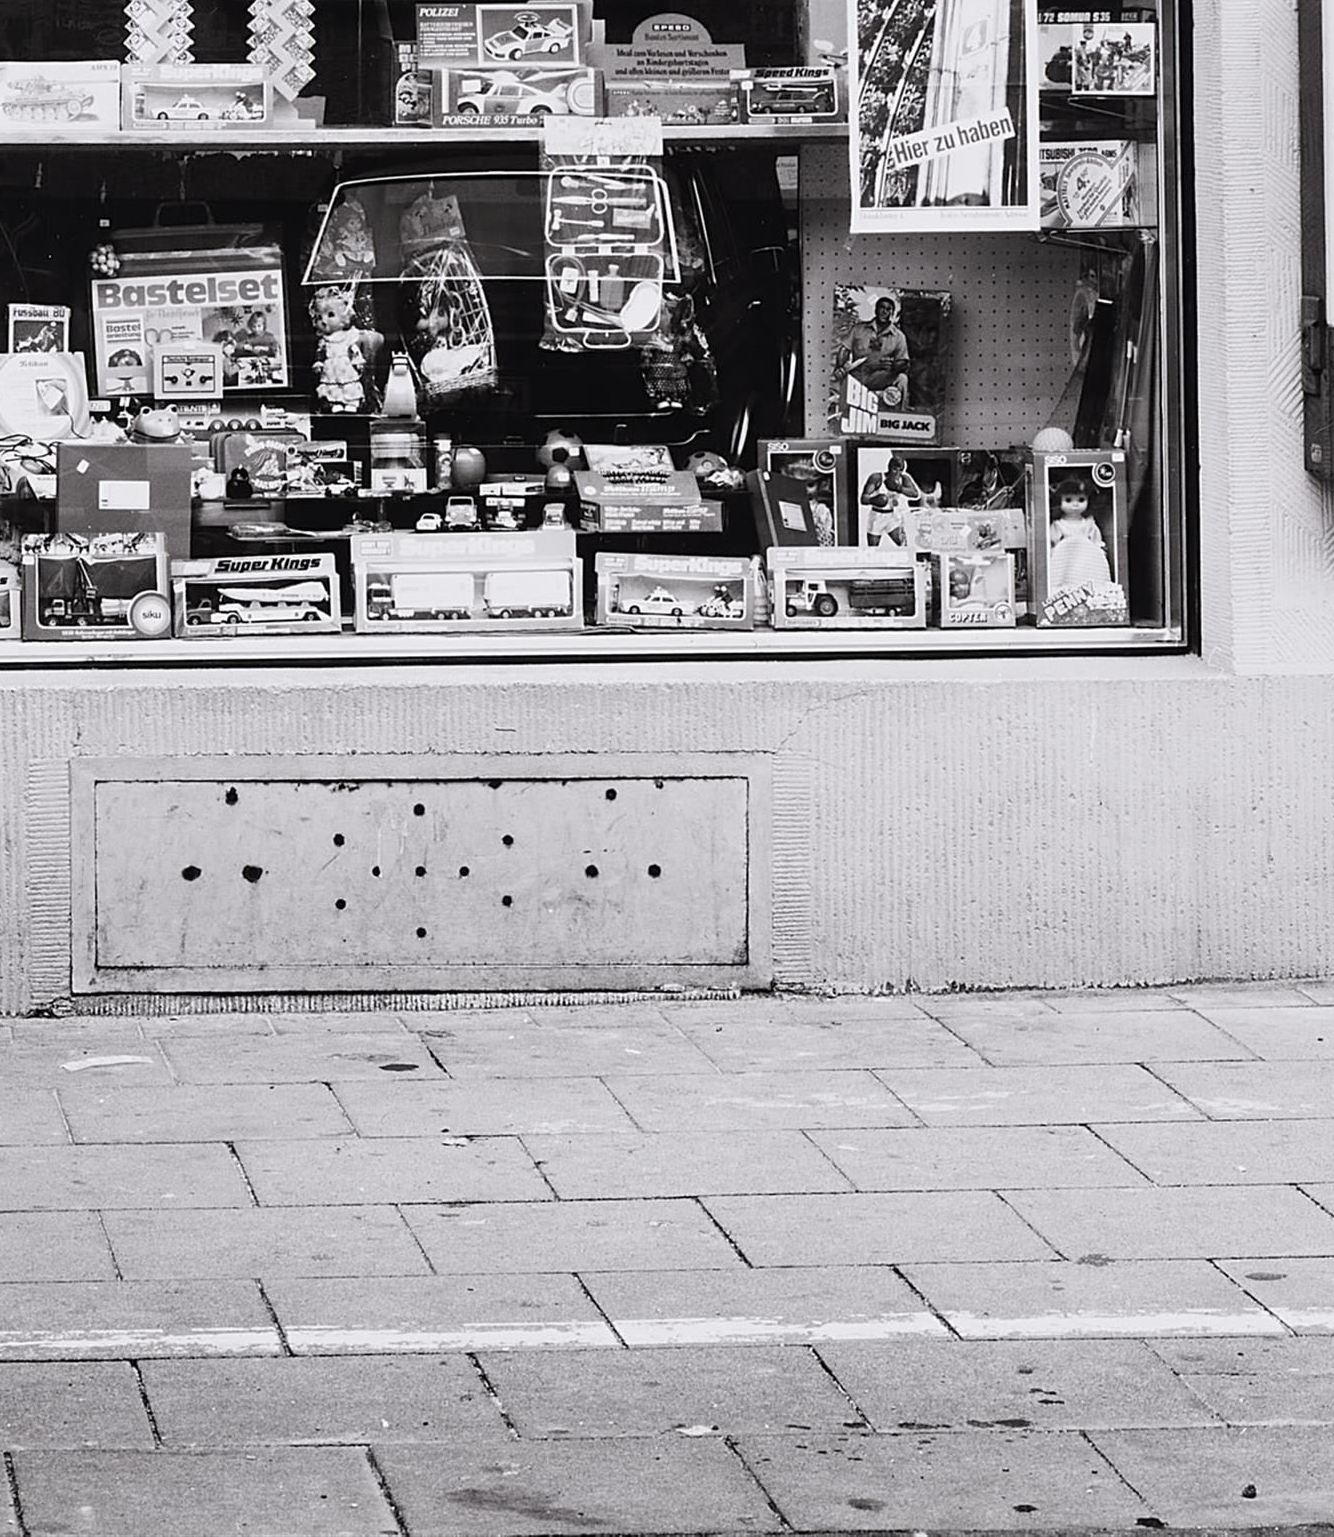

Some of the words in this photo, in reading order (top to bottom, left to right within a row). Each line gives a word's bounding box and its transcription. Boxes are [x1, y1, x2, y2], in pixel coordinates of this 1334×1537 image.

[419, 8, 459, 17] POLIZEI
[754, 69, 794, 78] Speed
[795, 68, 829, 77] Kings
[442, 115, 492, 125] PORSCHE
[494, 115, 509, 125] 935
[510, 115, 538, 125] Turbo
[893, 139, 929, 163] Hier
[934, 135, 955, 152] zu
[956, 117, 1012, 146] haben
[97, 274, 279, 308] Bastelset
[106, 323, 141, 333] Bastel
[846, 374, 879, 414] BIG
[841, 406, 878, 434] JIM
[880, 419, 899, 429] BIG
[901, 420, 931, 431] JACK
[215, 559, 269, 574] Super
[270, 557, 322, 572] Kings
[1044, 580, 1095, 622] PENNY
[142, 610, 162, 620] siku
[949, 613, 988, 623] COPTER
